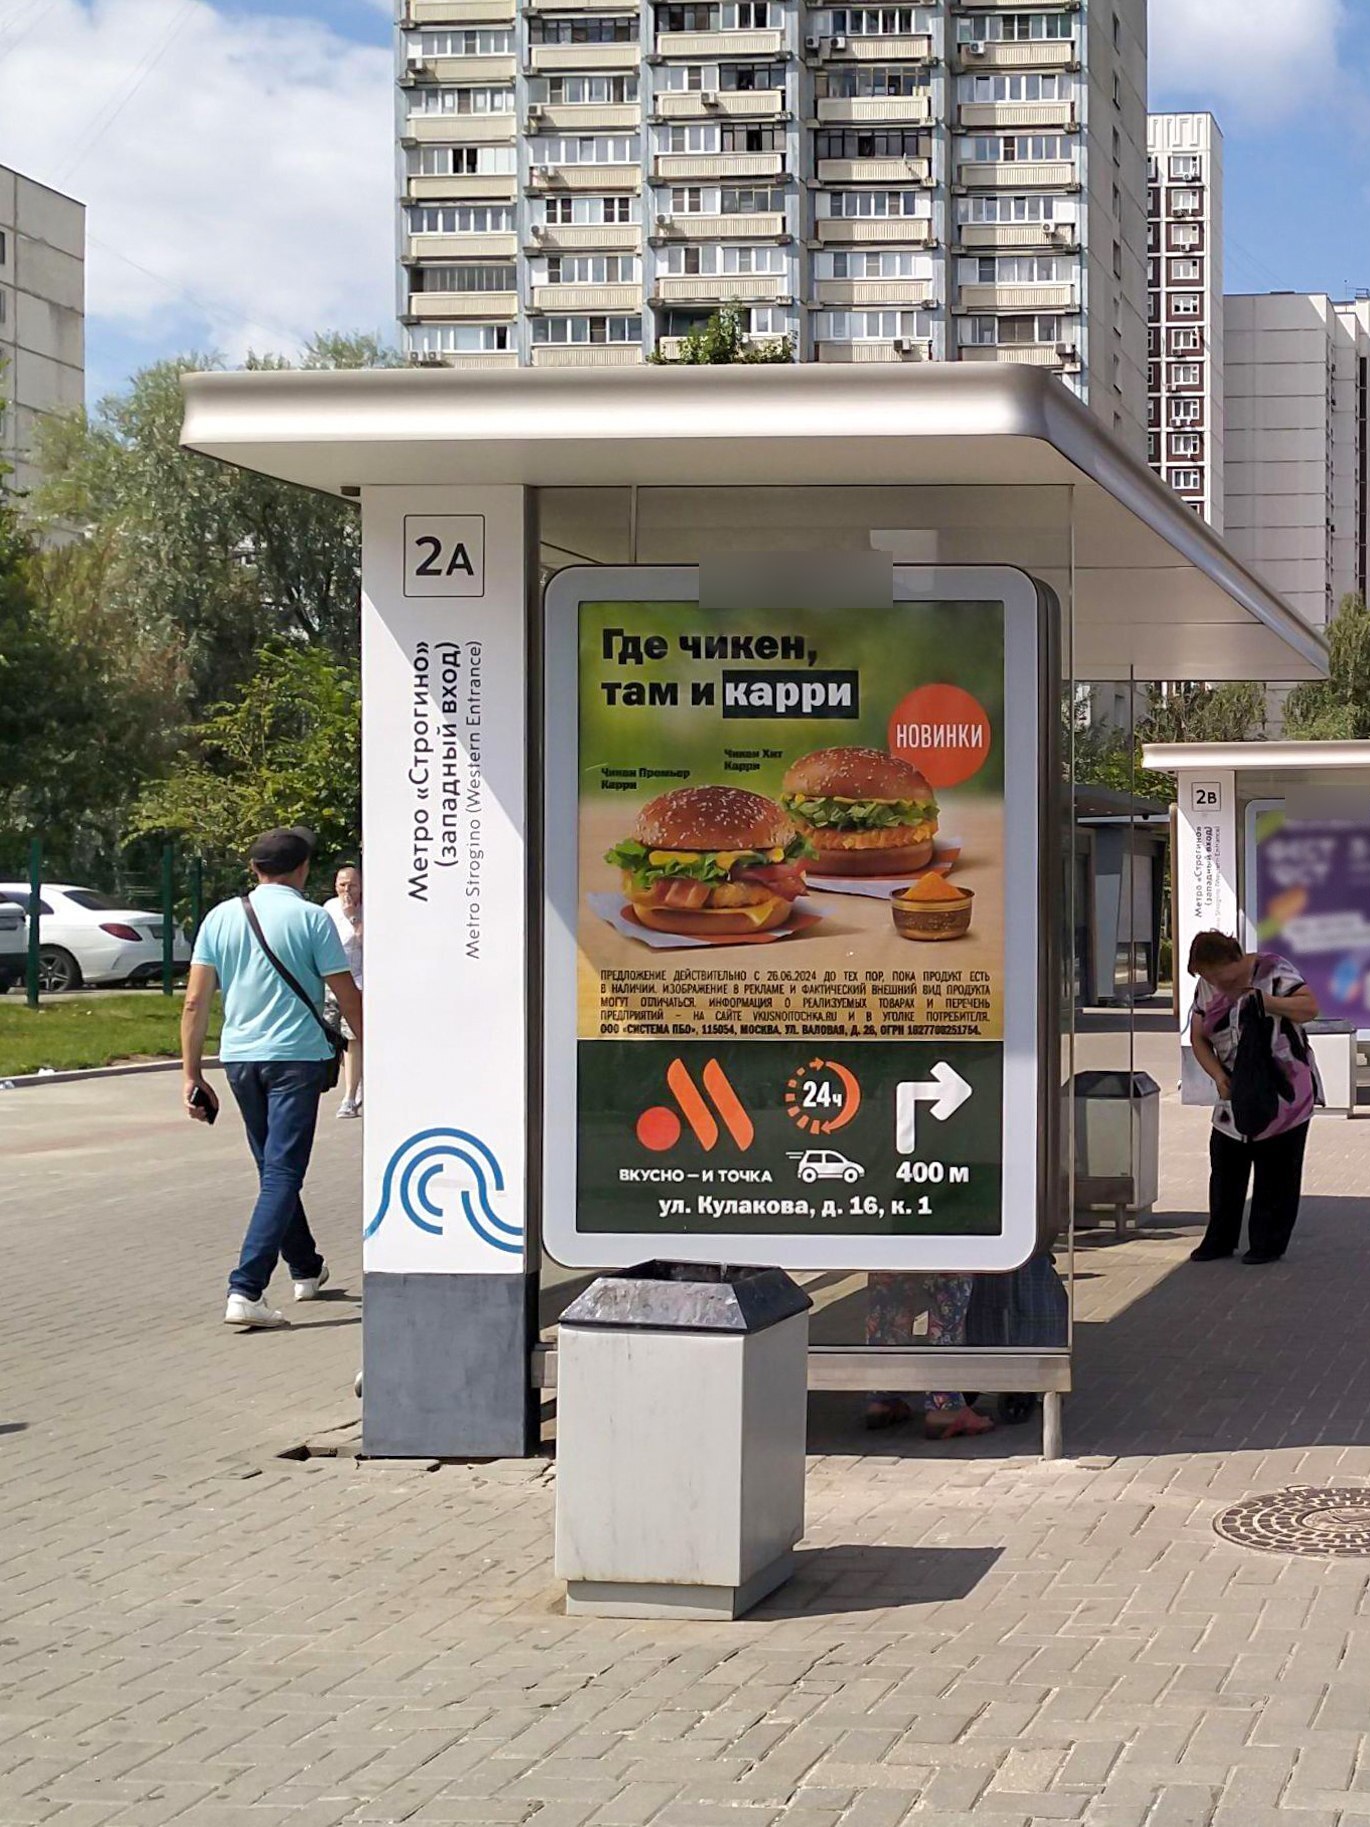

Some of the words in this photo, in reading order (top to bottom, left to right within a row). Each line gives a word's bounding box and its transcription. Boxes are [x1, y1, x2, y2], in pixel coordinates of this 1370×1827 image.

[415, 535, 474, 576] 2А
[601, 629, 668, 664] Где
[679, 634, 818, 667] чикен,
[435, 641, 460, 714] вход)
[466, 640, 481, 725] Entrance)
[601, 681, 678, 706] там
[691, 682, 715, 706] и
[725, 681, 851, 712] карри
[408, 641, 434, 800] «Строгино»
[897, 724, 982, 749] НОВИНКИ
[724, 762, 760, 772] Карри
[762, 750, 782, 758] Хит
[466, 732, 481, 814] (Western
[601, 780, 637, 791] Карри
[435, 723, 460, 868] (западный
[408, 811, 434, 902] Метро
[466, 818, 485, 897] Strogino
[1195, 885, 1203, 918] Метро
[466, 903, 480, 959] Metro
[601, 970, 666, 981] ПРЕДЛОЖЕНИЕ
[673, 968, 746, 981] ДЕЙСТВИТЕЛЬНО
[754, 970, 759, 981] С
[768, 970, 816, 981] 26.06.2024
[824, 970, 836, 981] ДО
[844, 970, 858, 981] ТЕХ
[865, 970, 885, 981] ПОР,
[892, 970, 916, 981] ПОКА
[923, 970, 961, 981] ПРОДУКТ
[970, 970, 990, 981] ЕСТЬ
[663, 984, 727, 995] ИЗОБРАЖЕНИЕ
[744, 984, 784, 995] РЕКЛАМЕ
[790, 984, 795, 995] И
[801, 983, 866, 995] ФАКТИЧЕСКИЙ
[872, 983, 917, 995] ВНЕШНИЙ
[923, 985, 941, 996] ВИД
[947, 985, 990, 996] ПРОДУКТА
[709, 997, 772, 1008] ИНФОРМАЦИЯ
[803, 997, 867, 1008] РЕАЛИЗУЕМЫХ
[879, 997, 914, 1008] ТОВАРАХ
[927, 997, 933, 1008] И
[946, 997, 990, 1008] ПЕРЕЧЕНЬ
[601, 1009, 664, 1021] ПРЕДПРИЯТИЙ
[693, 1011, 704, 1021] НА
[716, 1009, 741, 1021] САЙТЕ
[849, 1011, 854, 1021] И
[883, 1011, 914, 1021] УГОЛКЕ
[802, 1081, 842, 1108] 24ч
[619, 1169, 684, 1183] ВКУСНО
[702, 1170, 713, 1182] И
[718, 1169, 772, 1183] ТОЧКА
[896, 1162, 943, 1183] 400
[948, 1167, 969, 1183] м
[659, 1198, 690, 1218] ул.
[698, 1197, 815, 1216] Кулакова,
[821, 1201, 843, 1218] д.
[850, 1197, 884, 1217] 16,
[892, 1201, 912, 1215] к.
[918, 1197, 932, 1215] 1
